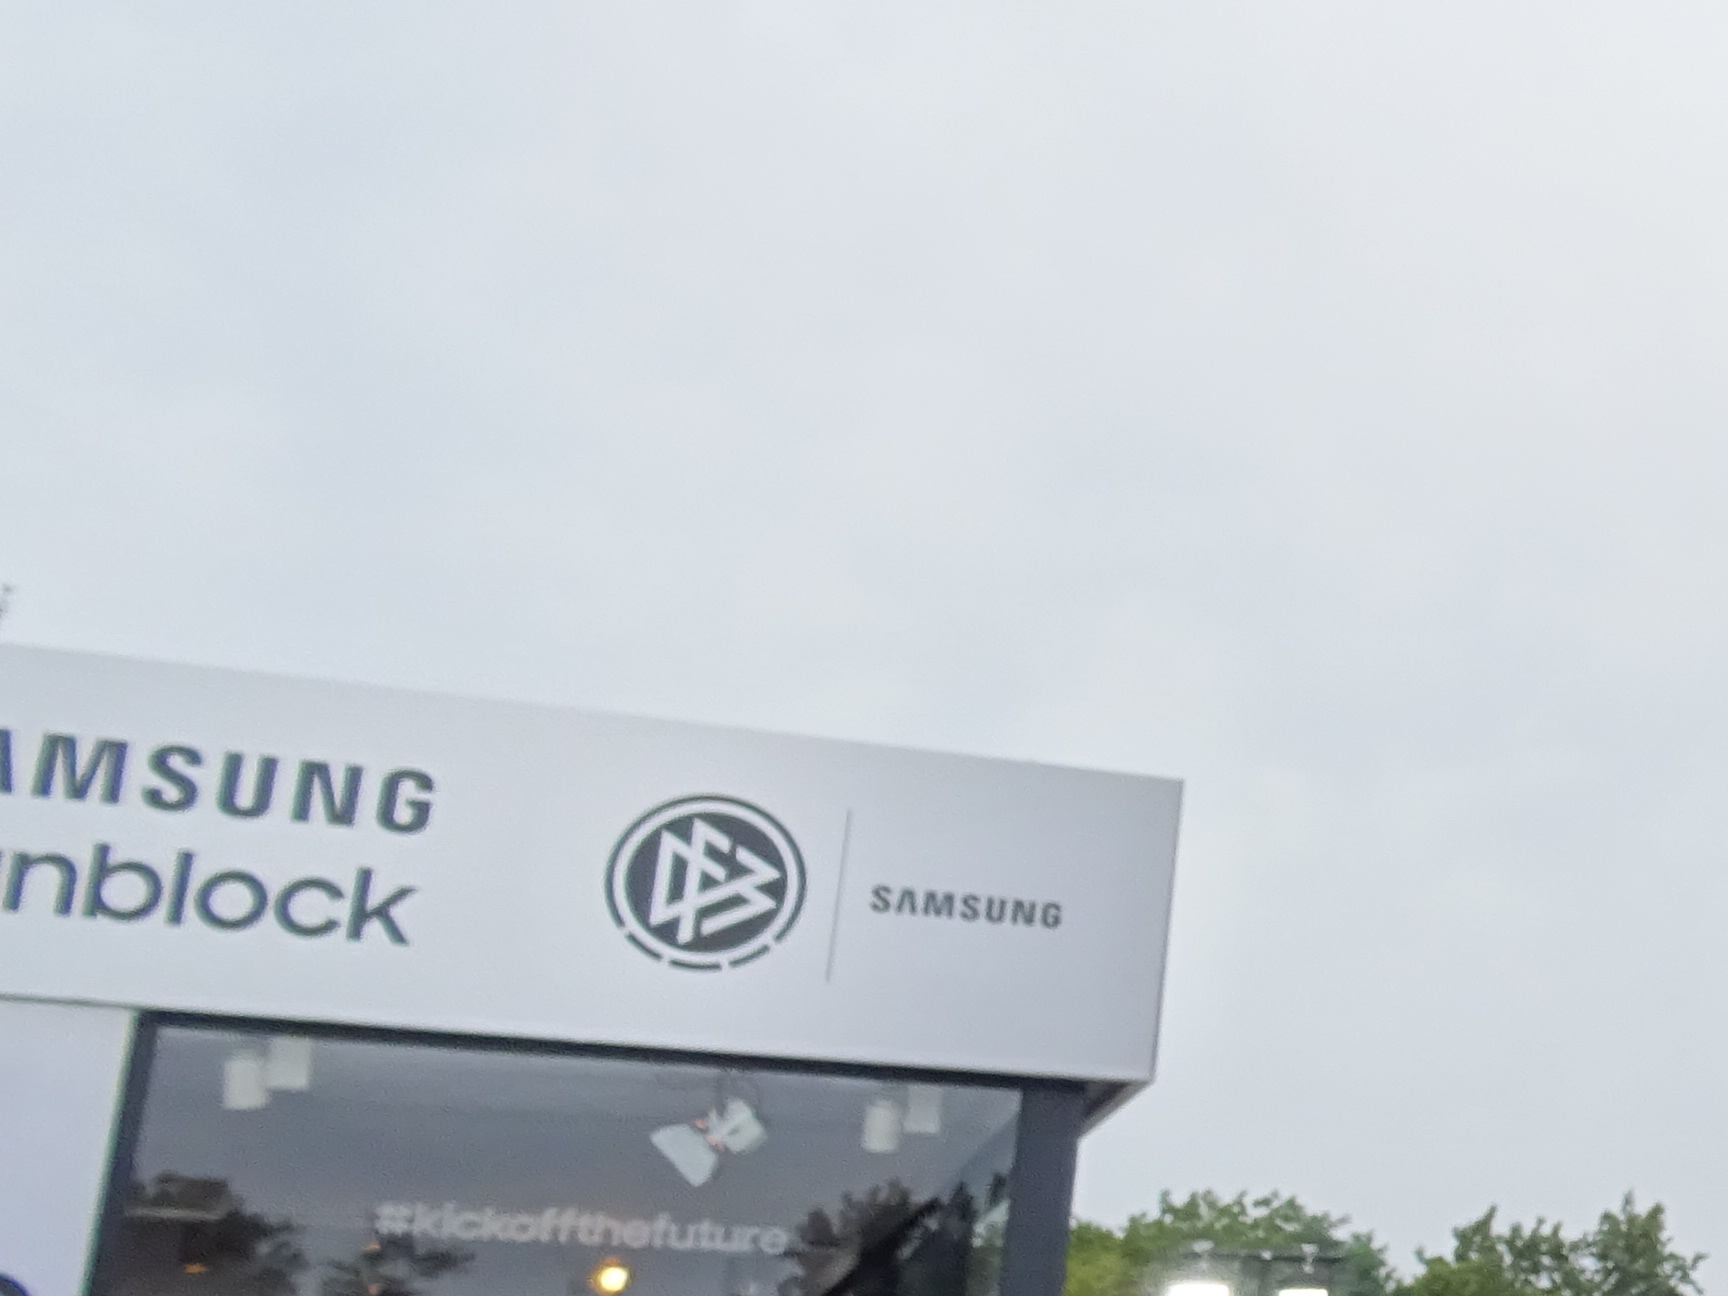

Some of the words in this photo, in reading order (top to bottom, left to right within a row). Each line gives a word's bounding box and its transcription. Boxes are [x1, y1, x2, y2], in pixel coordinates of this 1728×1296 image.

[0, 726, 435, 836] MSUNG
[0, 843, 418, 947] nblock
[870, 883, 1064, 931] SAMSUNG
